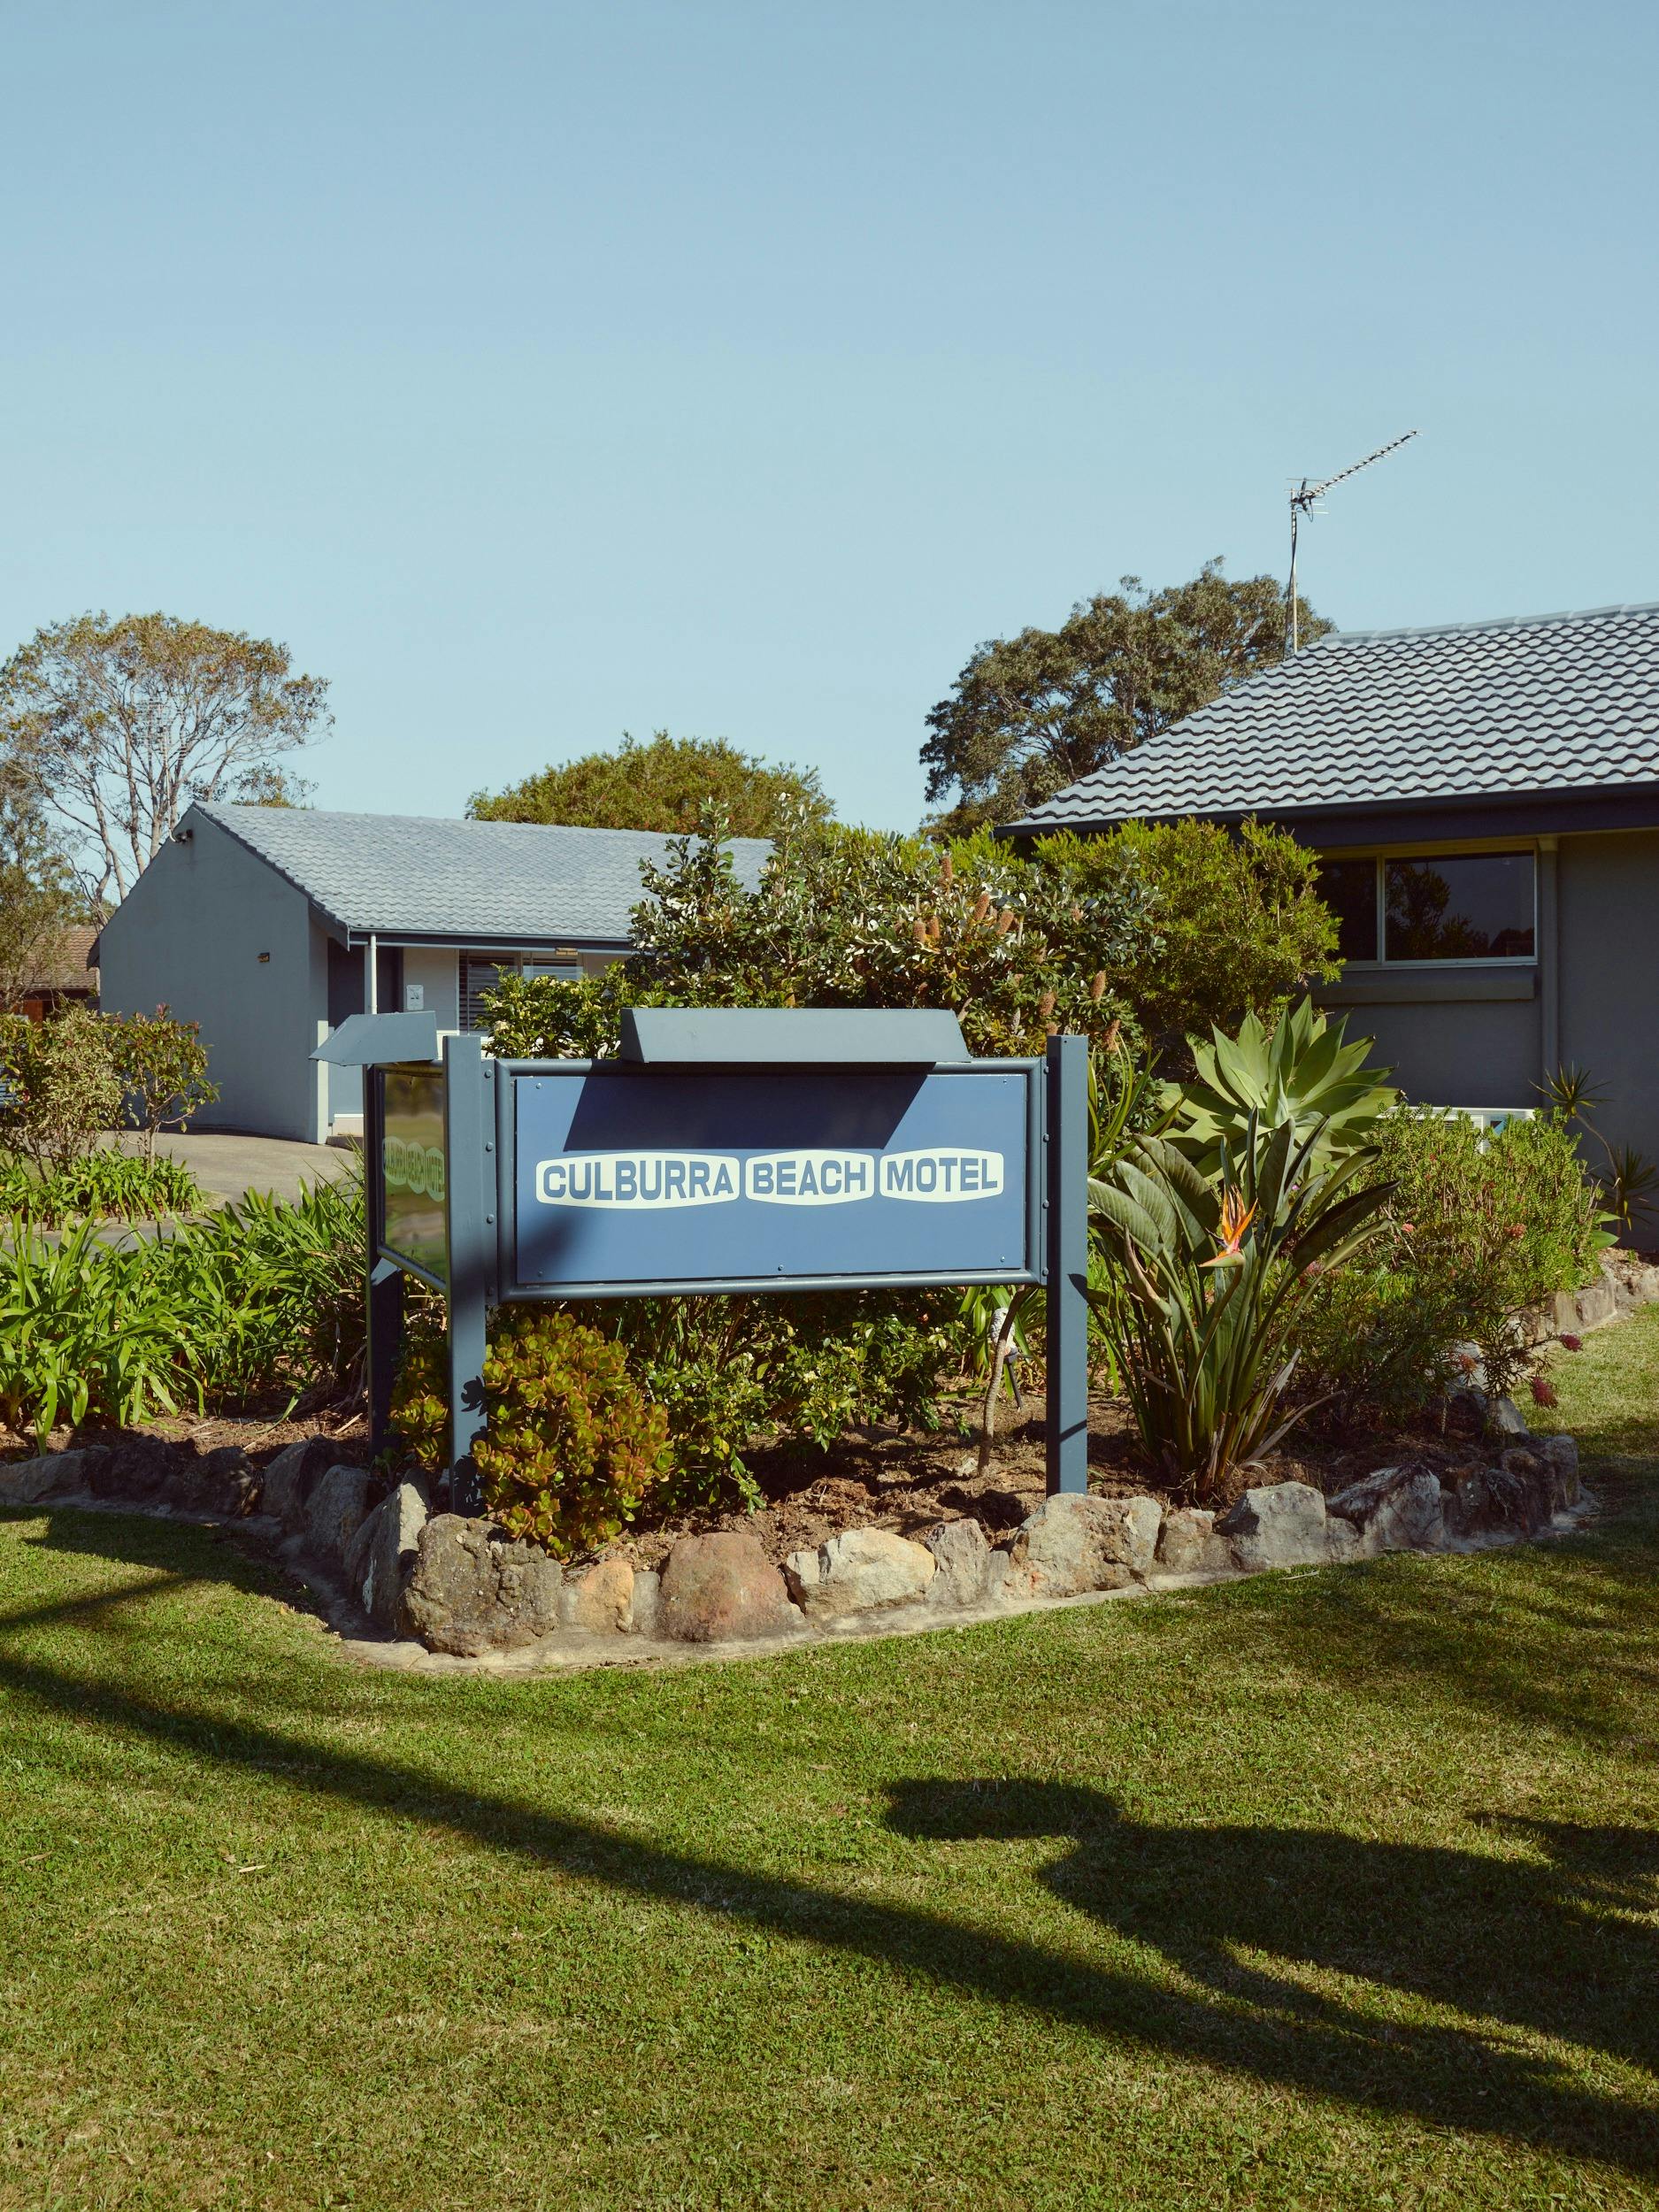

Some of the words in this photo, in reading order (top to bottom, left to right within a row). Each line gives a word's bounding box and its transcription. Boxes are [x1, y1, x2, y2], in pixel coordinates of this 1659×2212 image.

[543, 1160, 734, 1201] CULBURRA
[753, 1159, 866, 1195] BEACH
[887, 1157, 998, 1193] MOTEL
